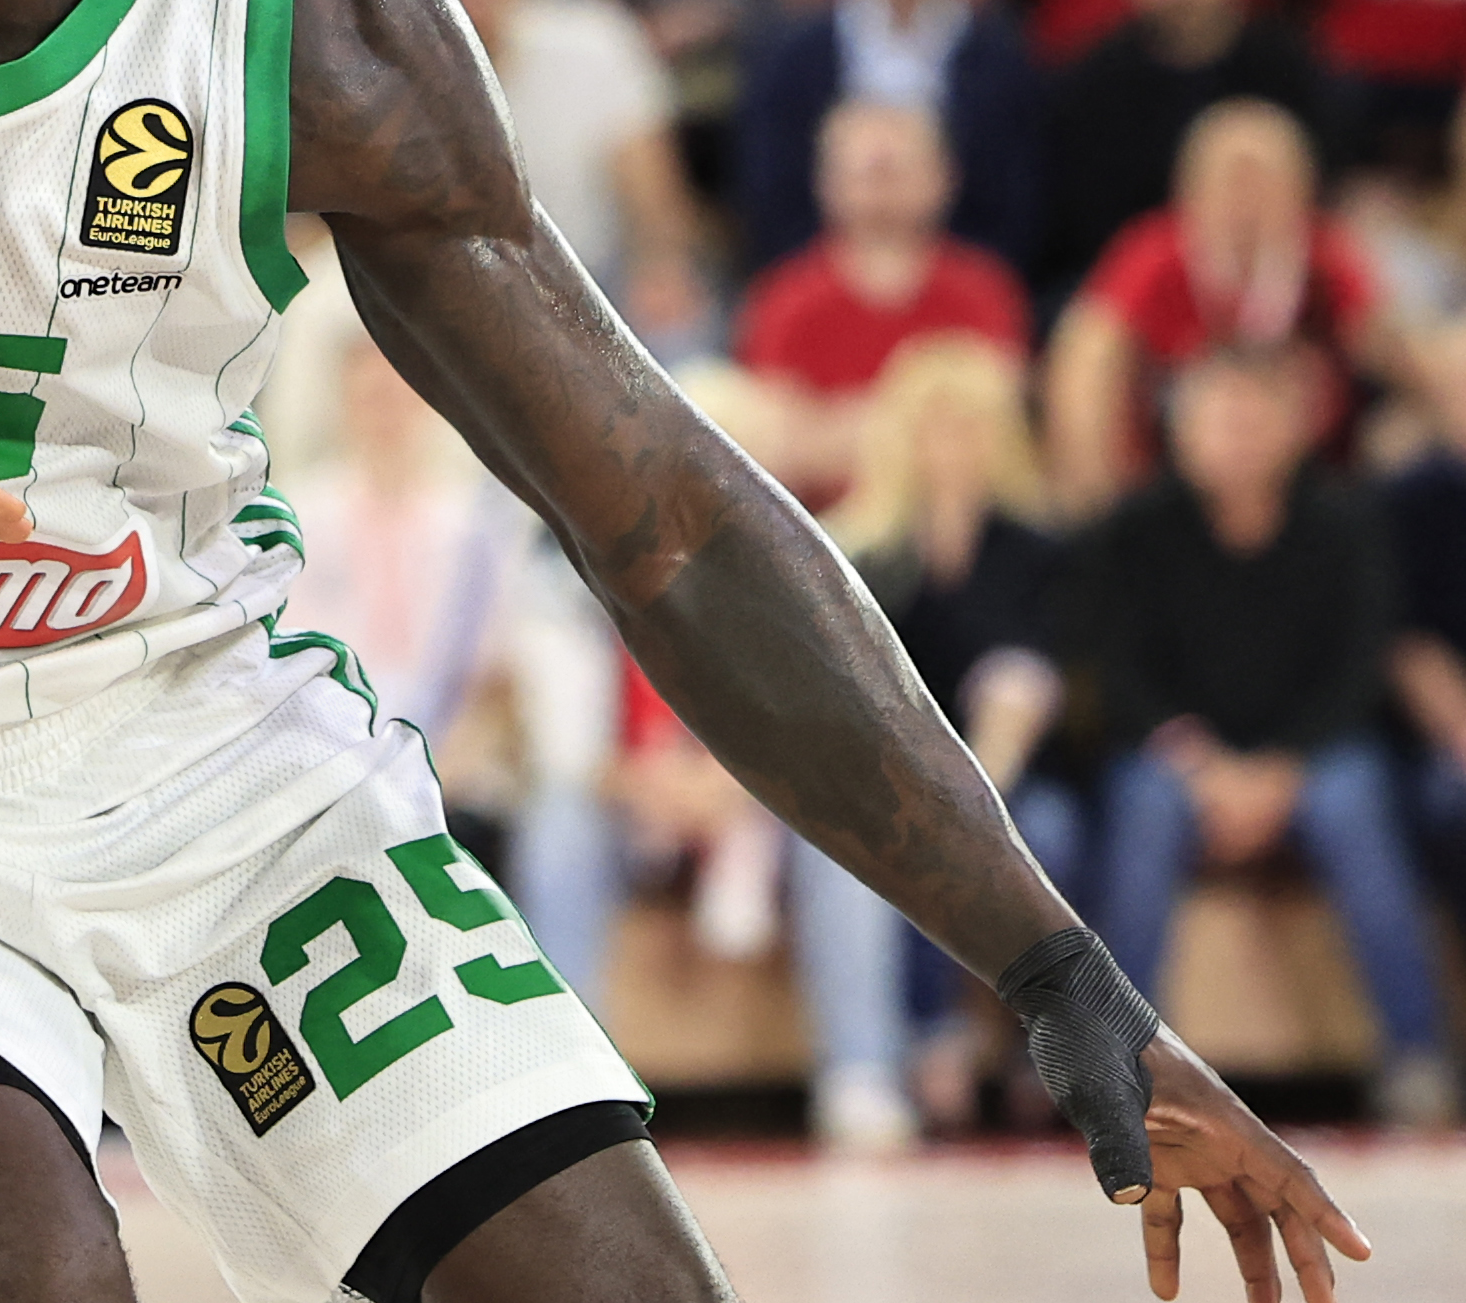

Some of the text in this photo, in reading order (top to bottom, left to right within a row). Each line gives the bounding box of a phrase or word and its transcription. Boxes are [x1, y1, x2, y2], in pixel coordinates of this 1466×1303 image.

[92, 214, 173, 235] AIRLINES
[96, 197, 175, 219] TURKISH
[89, 228, 171, 250] EuroLeague
[260, 833, 567, 1102] 25
[239, 1048, 293, 1097] TURKISH
[247, 1062, 300, 1112] AIRLINES
[253, 1075, 307, 1124] EuroLeague
